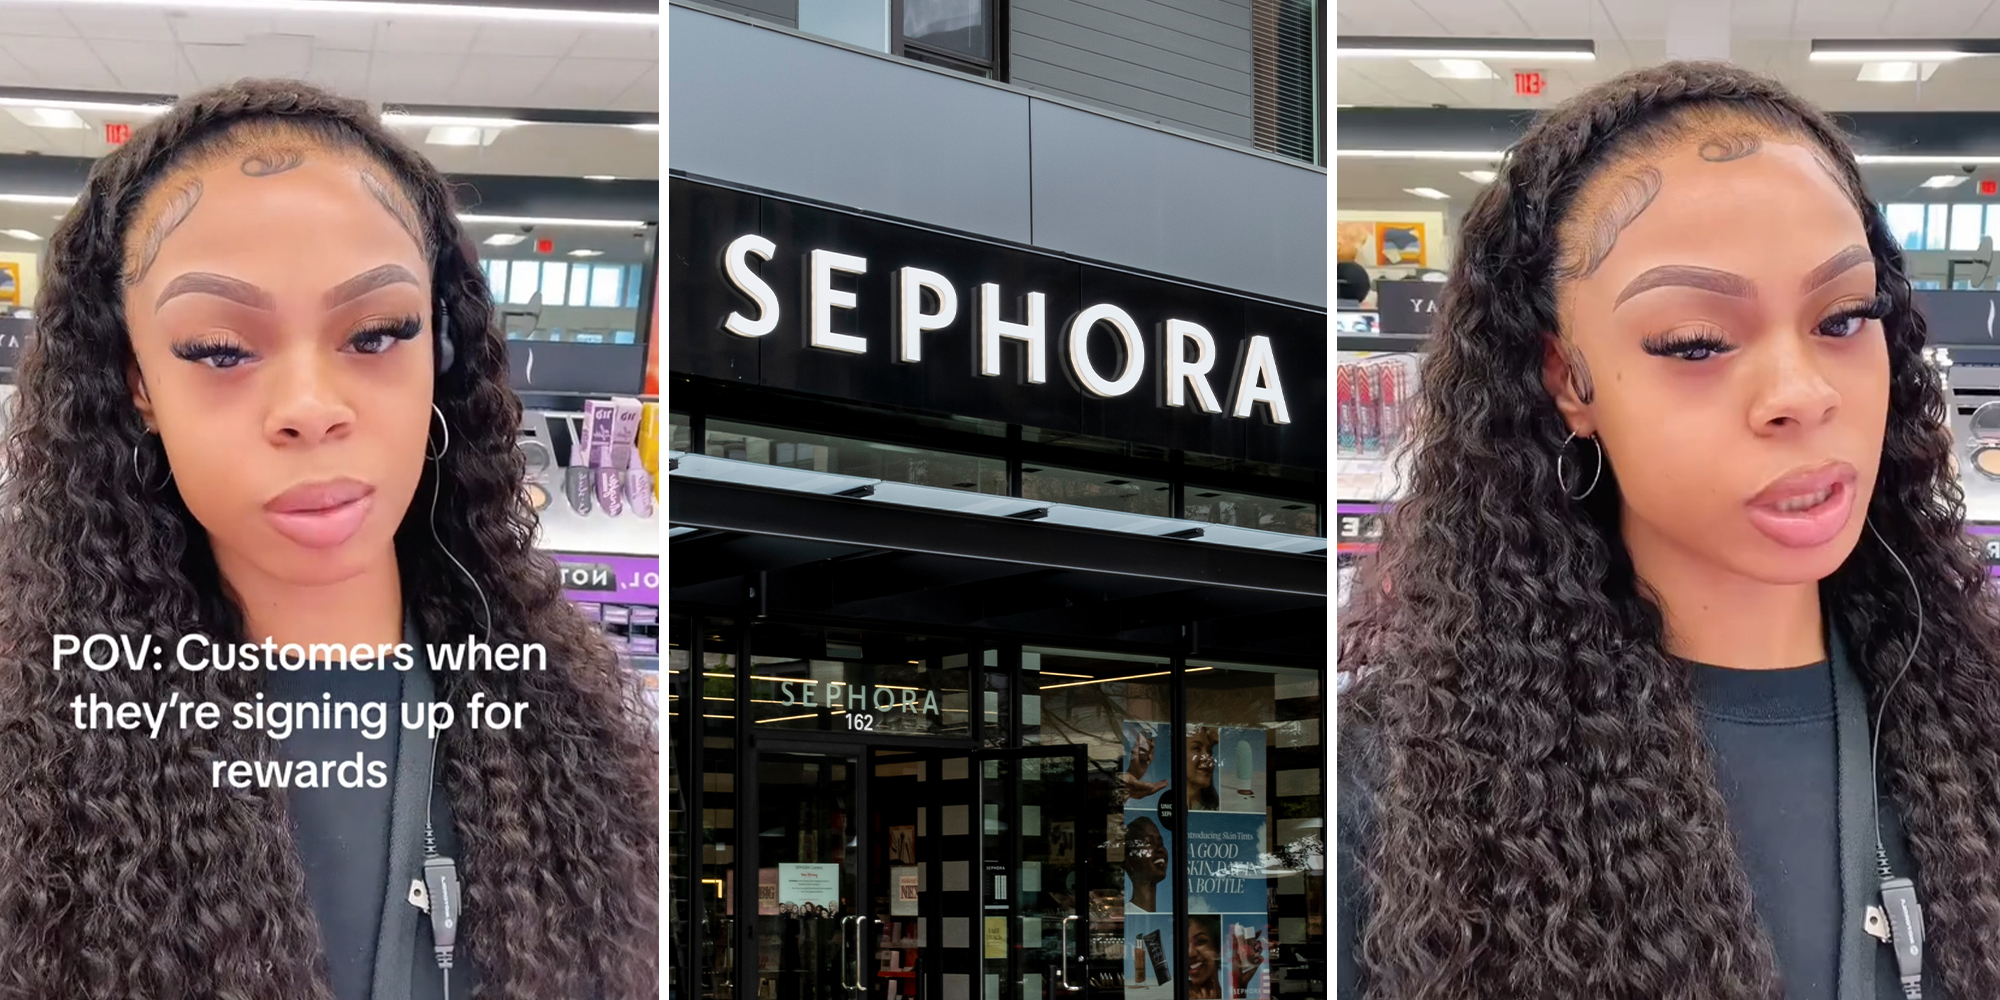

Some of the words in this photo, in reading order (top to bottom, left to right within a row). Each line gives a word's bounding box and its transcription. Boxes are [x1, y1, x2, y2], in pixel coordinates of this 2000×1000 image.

[724, 234, 1292, 424] SEPHORA
[781, 681, 939, 716] SEPHORA
[845, 713, 873, 731] 162
[1222, 831, 1236, 840] Skin
[1237, 831, 1254, 840] Tints
[1197, 842, 1239, 859] GOOD
[1196, 877, 1246, 894] BOTTLE
